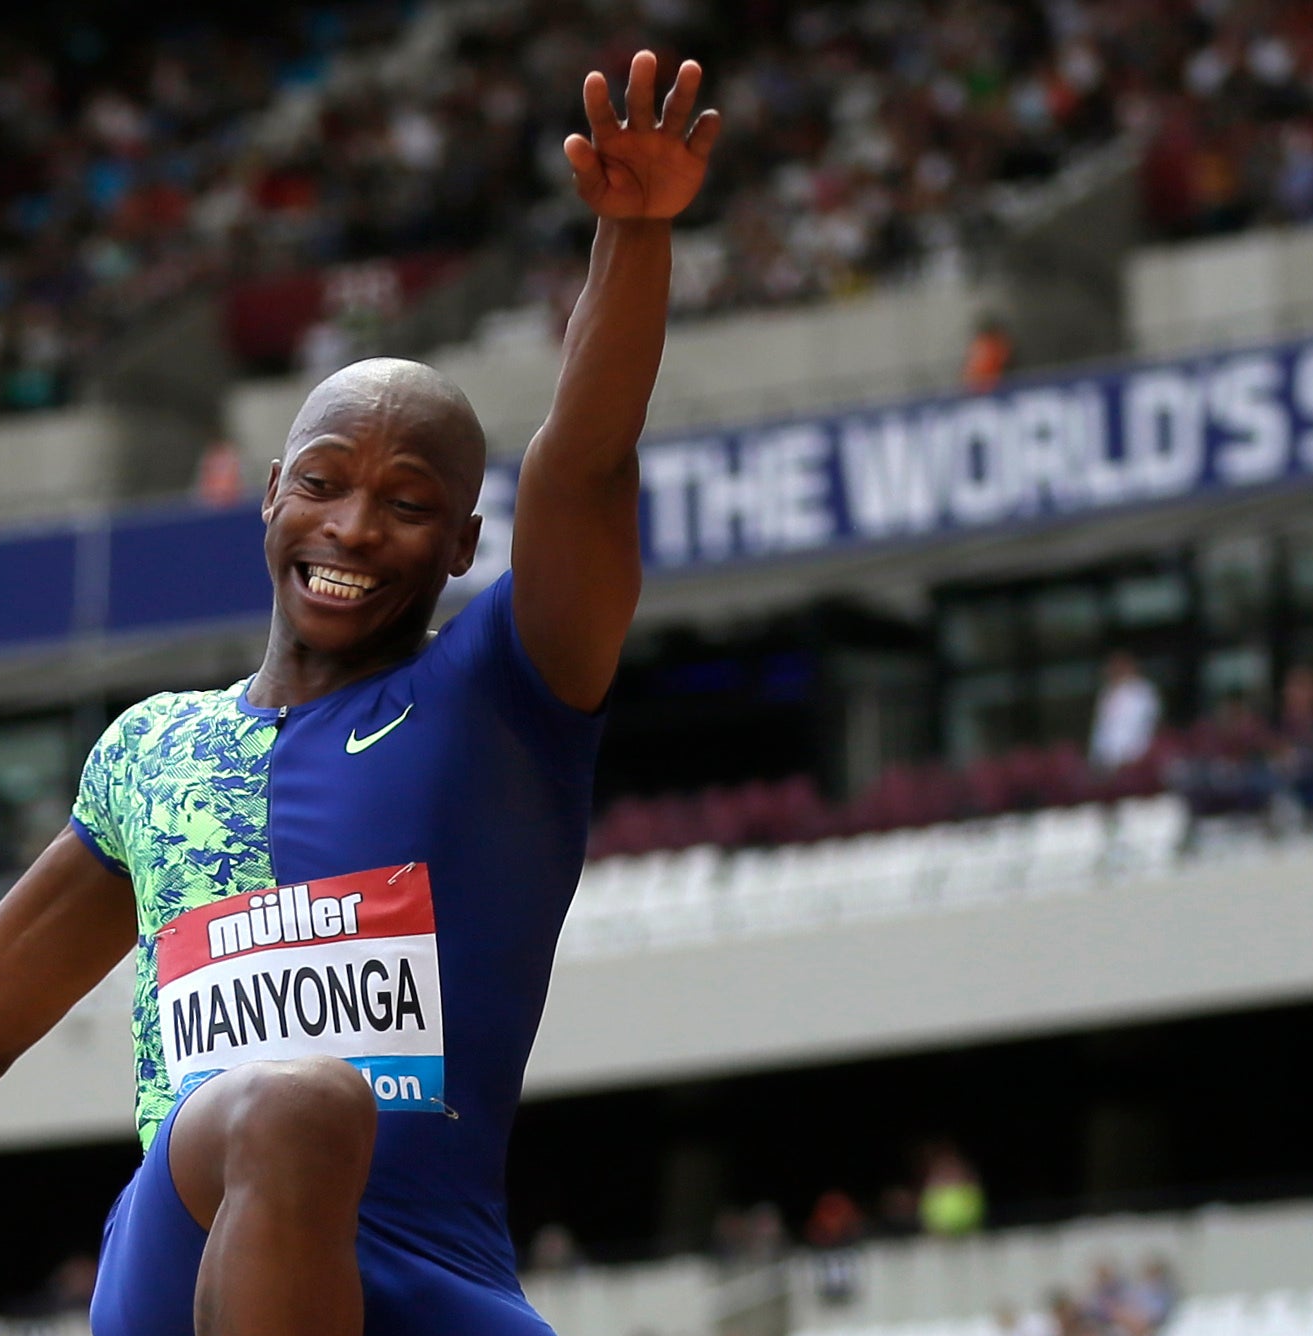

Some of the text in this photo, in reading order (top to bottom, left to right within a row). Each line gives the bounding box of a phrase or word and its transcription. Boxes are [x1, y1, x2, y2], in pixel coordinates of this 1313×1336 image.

[645, 424, 835, 567] THE
[837, 364, 1286, 535] WORLD'S
[207, 884, 362, 959] müller
[173, 958, 426, 1061] MANYONGA
